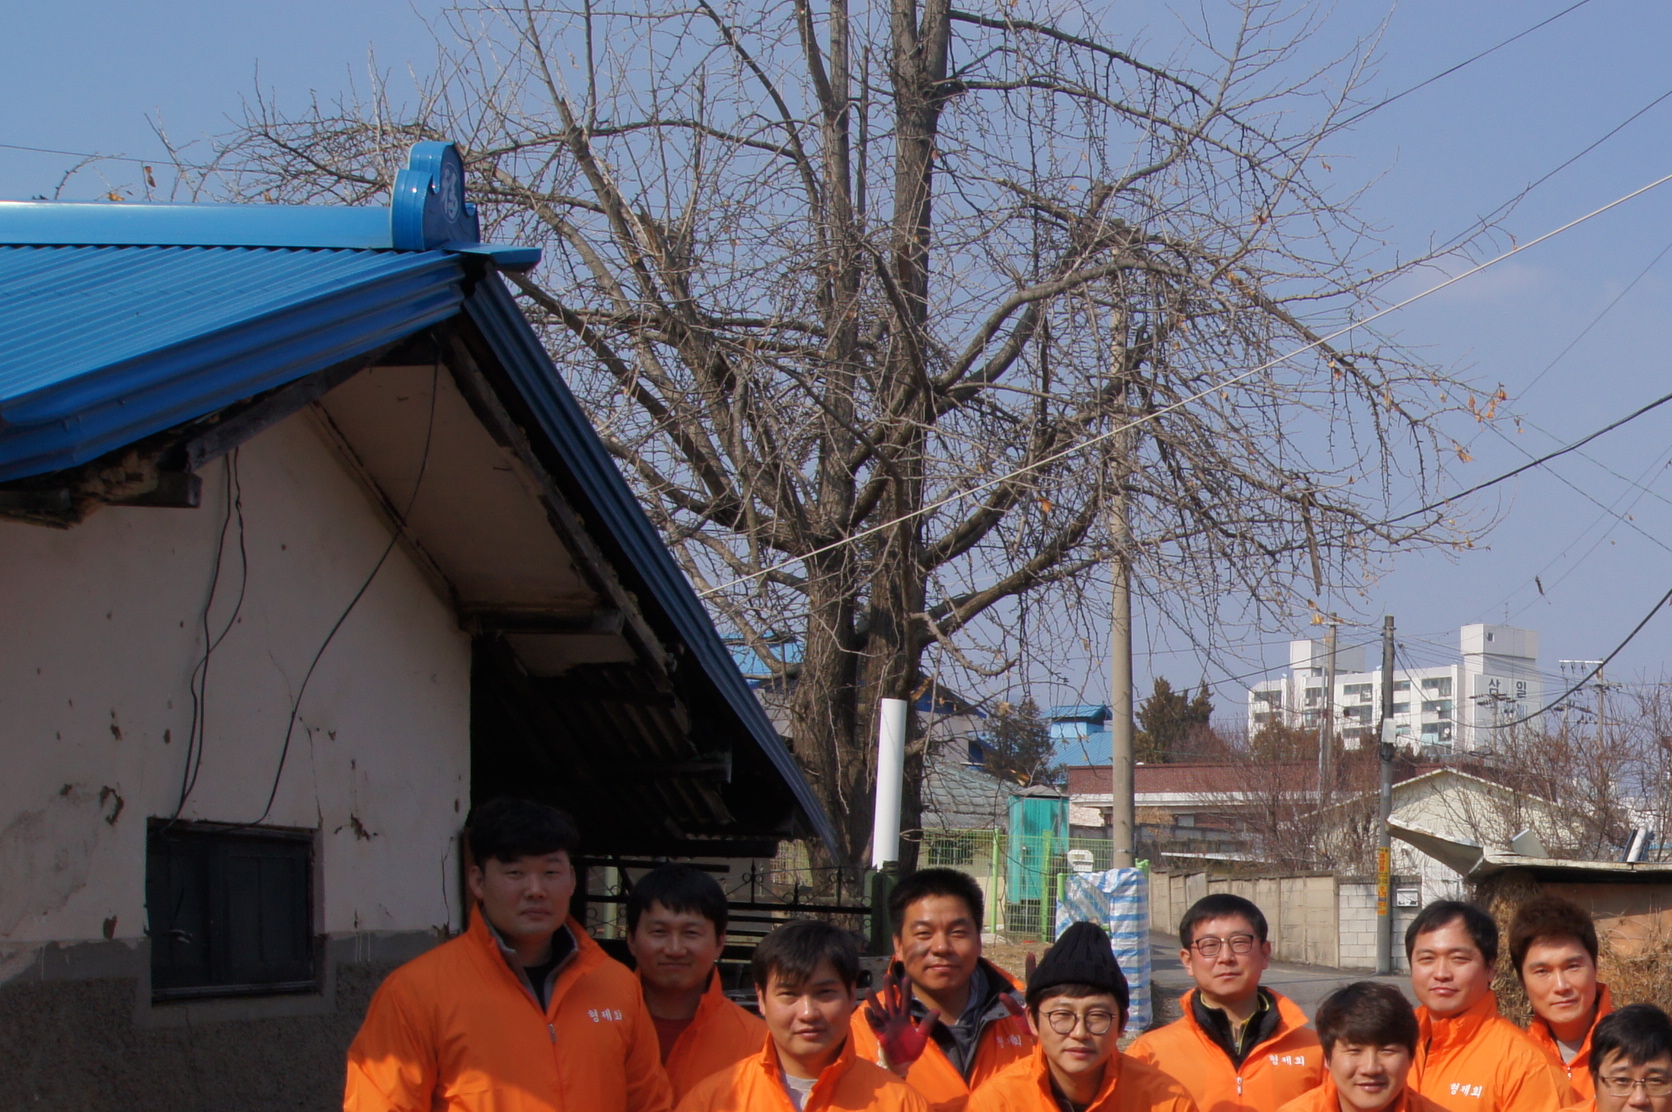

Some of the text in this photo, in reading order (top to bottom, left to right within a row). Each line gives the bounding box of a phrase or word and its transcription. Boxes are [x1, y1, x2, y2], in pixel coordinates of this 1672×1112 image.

[587, 1008, 623, 1023] 형제회
[1268, 1054, 1305, 1066] 형제회
[1449, 1083, 1482, 1099] 형제회
